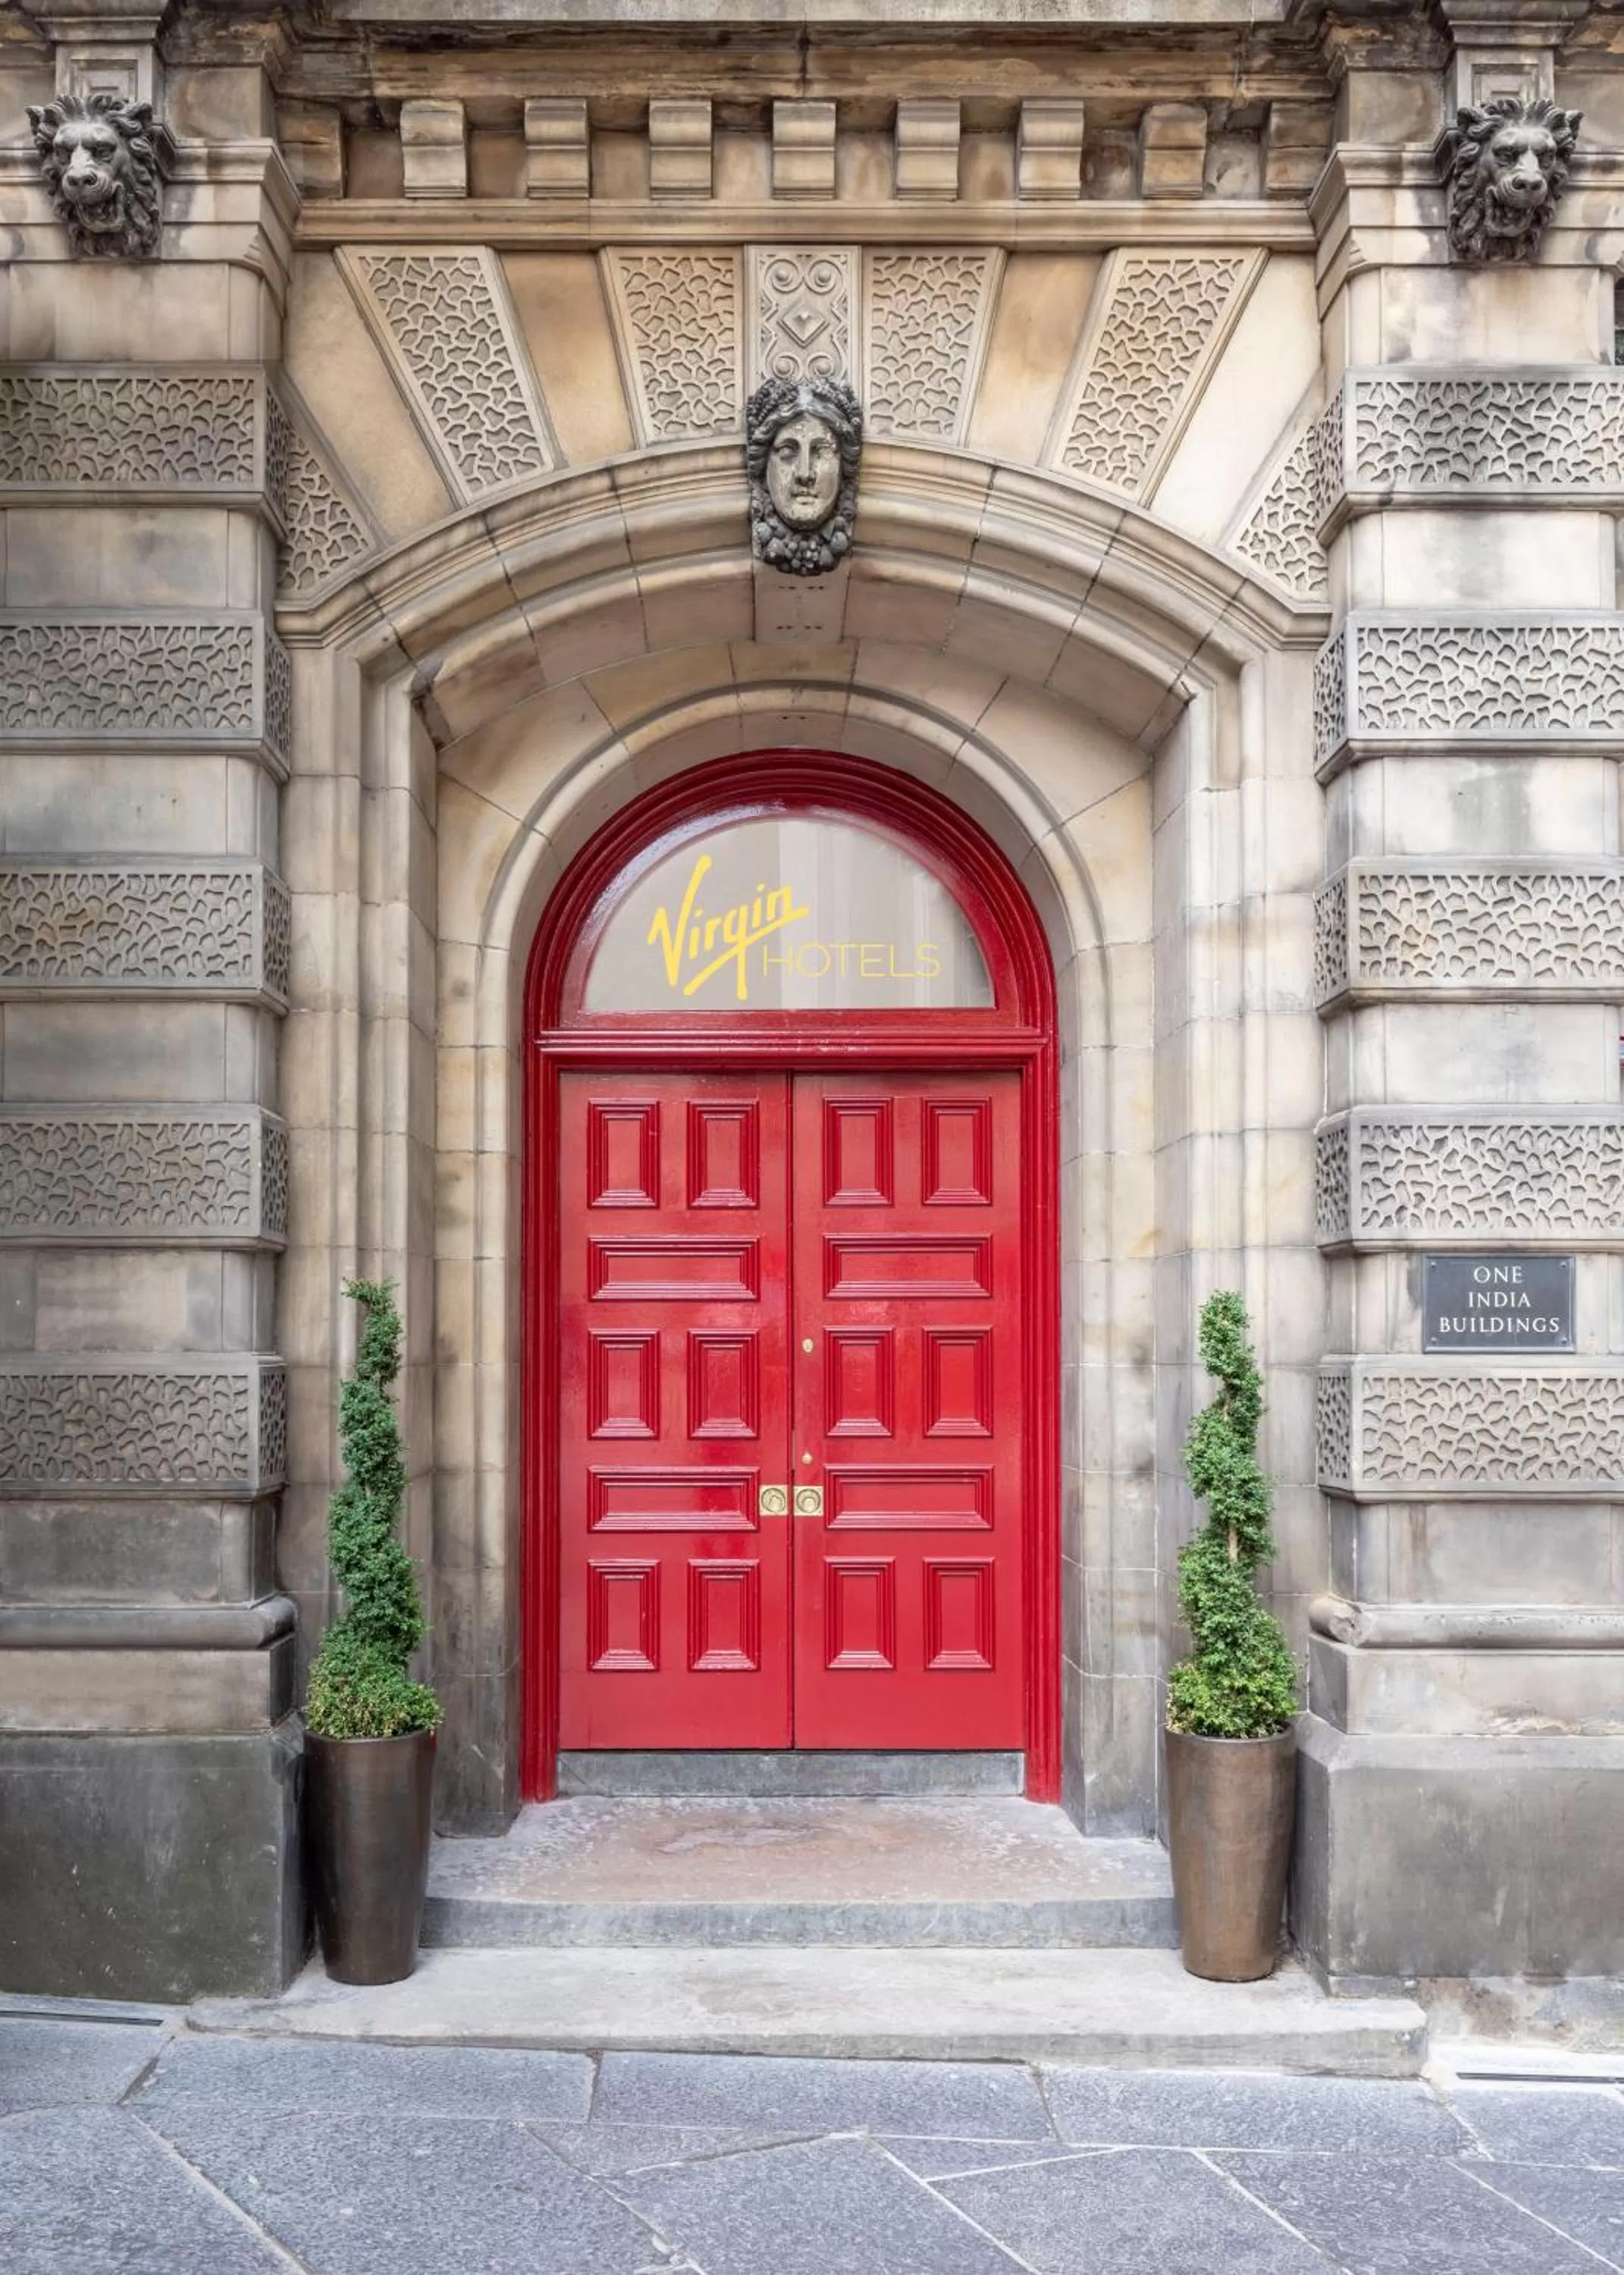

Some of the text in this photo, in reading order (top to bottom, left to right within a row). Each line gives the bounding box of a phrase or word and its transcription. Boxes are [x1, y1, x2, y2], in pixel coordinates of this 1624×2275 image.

[647, 855, 810, 999] Virgin
[763, 943, 942, 978] HOTELS
[1473, 1265, 1524, 1284] ONE
[1468, 1291, 1532, 1307] INDIA
[1439, 1317, 1560, 1333] BUILDINGS
